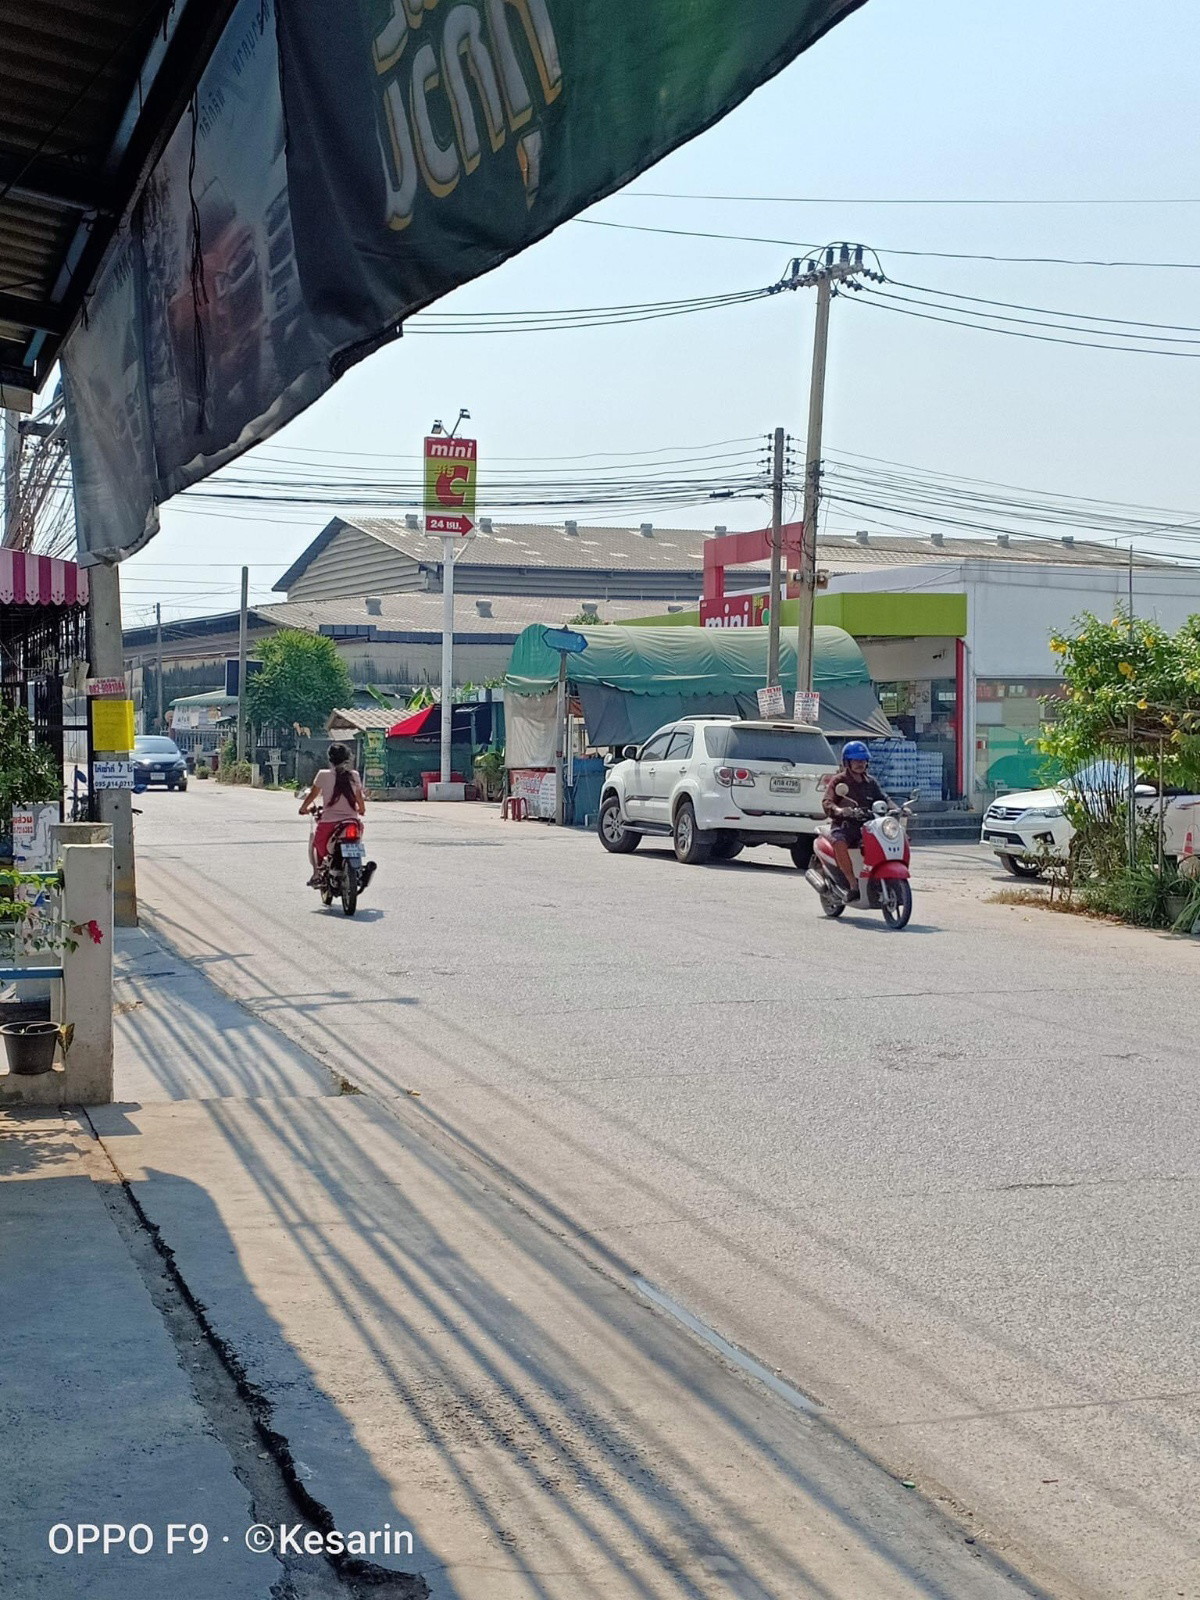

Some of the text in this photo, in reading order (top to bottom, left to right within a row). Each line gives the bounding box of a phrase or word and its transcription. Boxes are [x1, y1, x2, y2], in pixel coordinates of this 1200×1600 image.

[430, 440, 474, 458] mini
[436, 465, 470, 507] C
[430, 519, 445, 529] 24
[705, 600, 750, 628] mini
